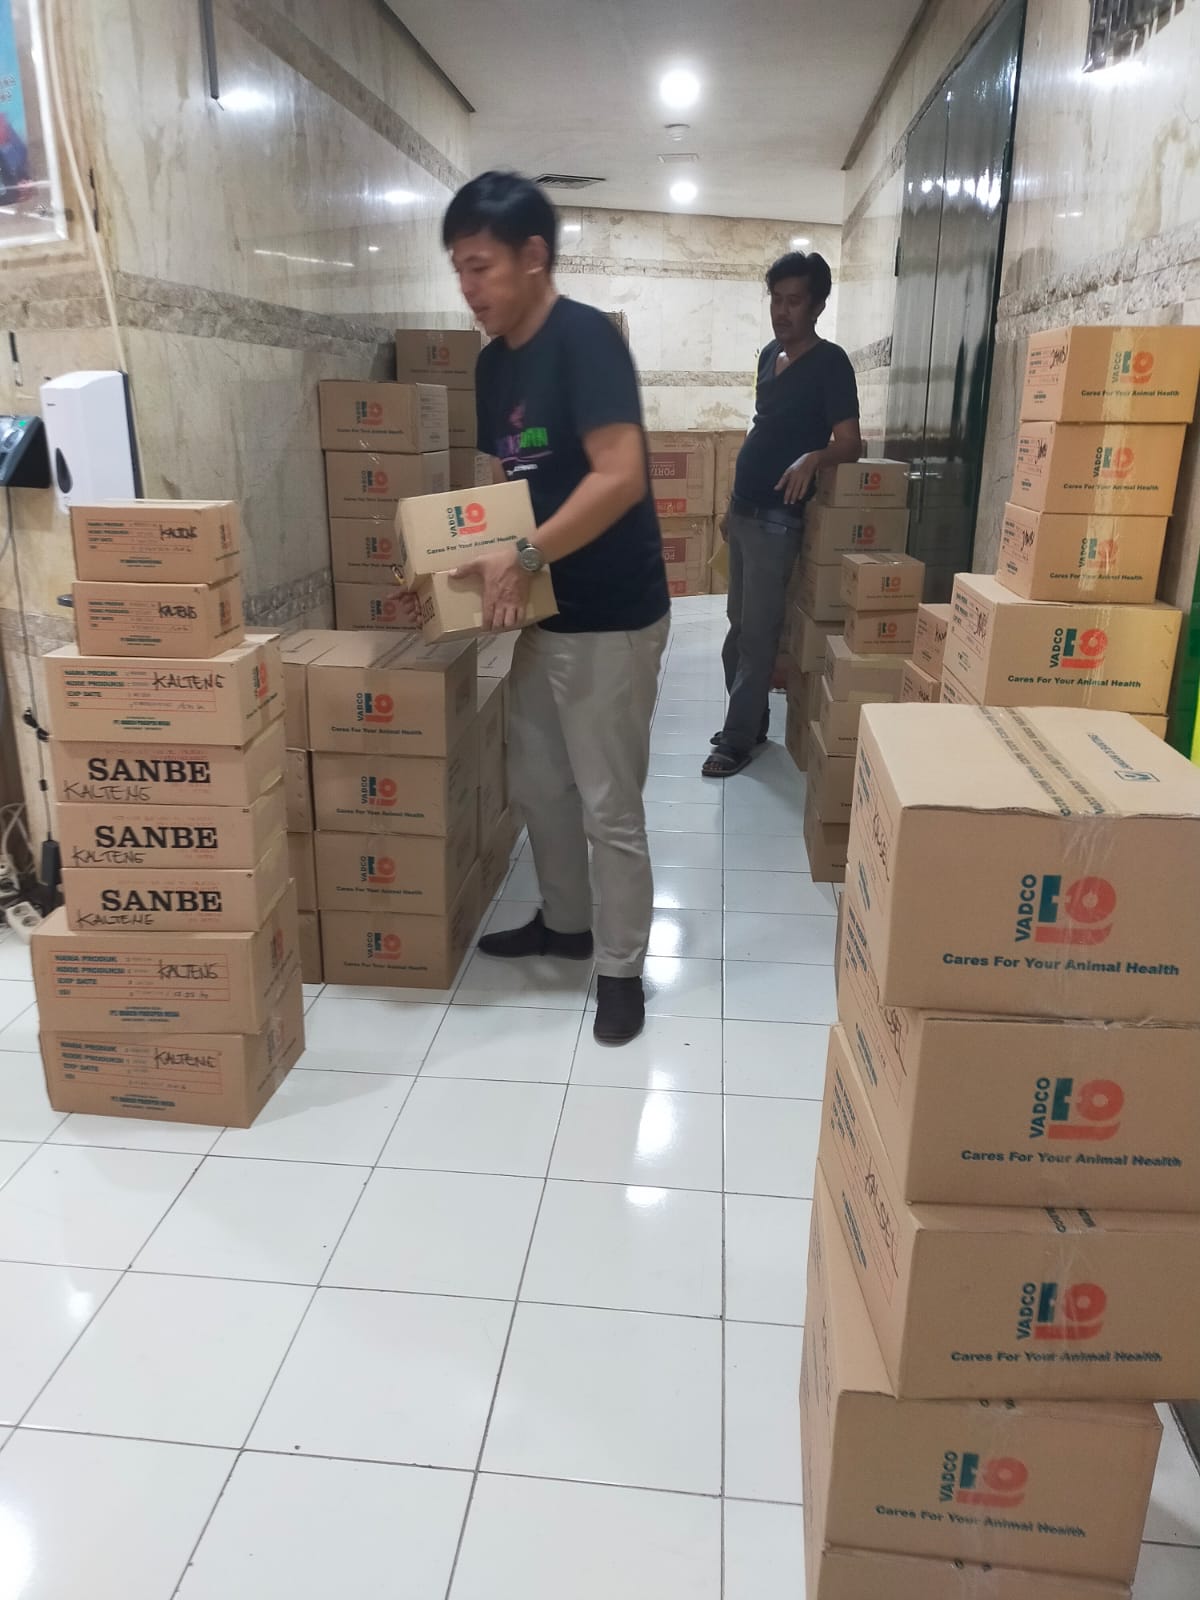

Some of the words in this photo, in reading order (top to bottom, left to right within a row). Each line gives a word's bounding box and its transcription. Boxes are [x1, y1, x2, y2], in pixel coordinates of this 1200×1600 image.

[447, 507, 458, 537] VADCO
[1049, 627, 1064, 668] VADCO
[1007, 675, 1034, 683] Cares
[1036, 676, 1052, 684] For
[1054, 677, 1075, 686] Your
[1076, 678, 1109, 687] Animal
[1111, 679, 1141, 688] Health
[356, 692, 364, 722] VADCO
[87, 757, 211, 783] SANBE
[360, 776, 369, 804] VADCO
[95, 825, 219, 849] SANBE
[101, 889, 223, 912] SANBE
[1014, 873, 1037, 942] VADCO
[942, 953, 989, 967] Cares
[993, 956, 1020, 968] For
[1024, 957, 1061, 970] Your
[1064, 959, 1121, 973] Animal
[1125, 962, 1180, 976] Health
[1029, 1077, 1051, 1139] VADCO
[961, 1150, 1005, 1161] Cares
[1009, 1151, 1034, 1163] For
[1037, 1152, 1073, 1165] Your
[1074, 1154, 1128, 1166] Animal
[1131, 1155, 1183, 1168] Health
[1016, 1282, 1037, 1341] VADCO
[951, 1351, 993, 1362] Cares
[997, 1351, 1019, 1362] For
[1024, 1351, 1058, 1362] Your
[939, 1450, 958, 1502] VADCO
[875, 1504, 917, 1519] Cares
[920, 1510, 944, 1521] For
